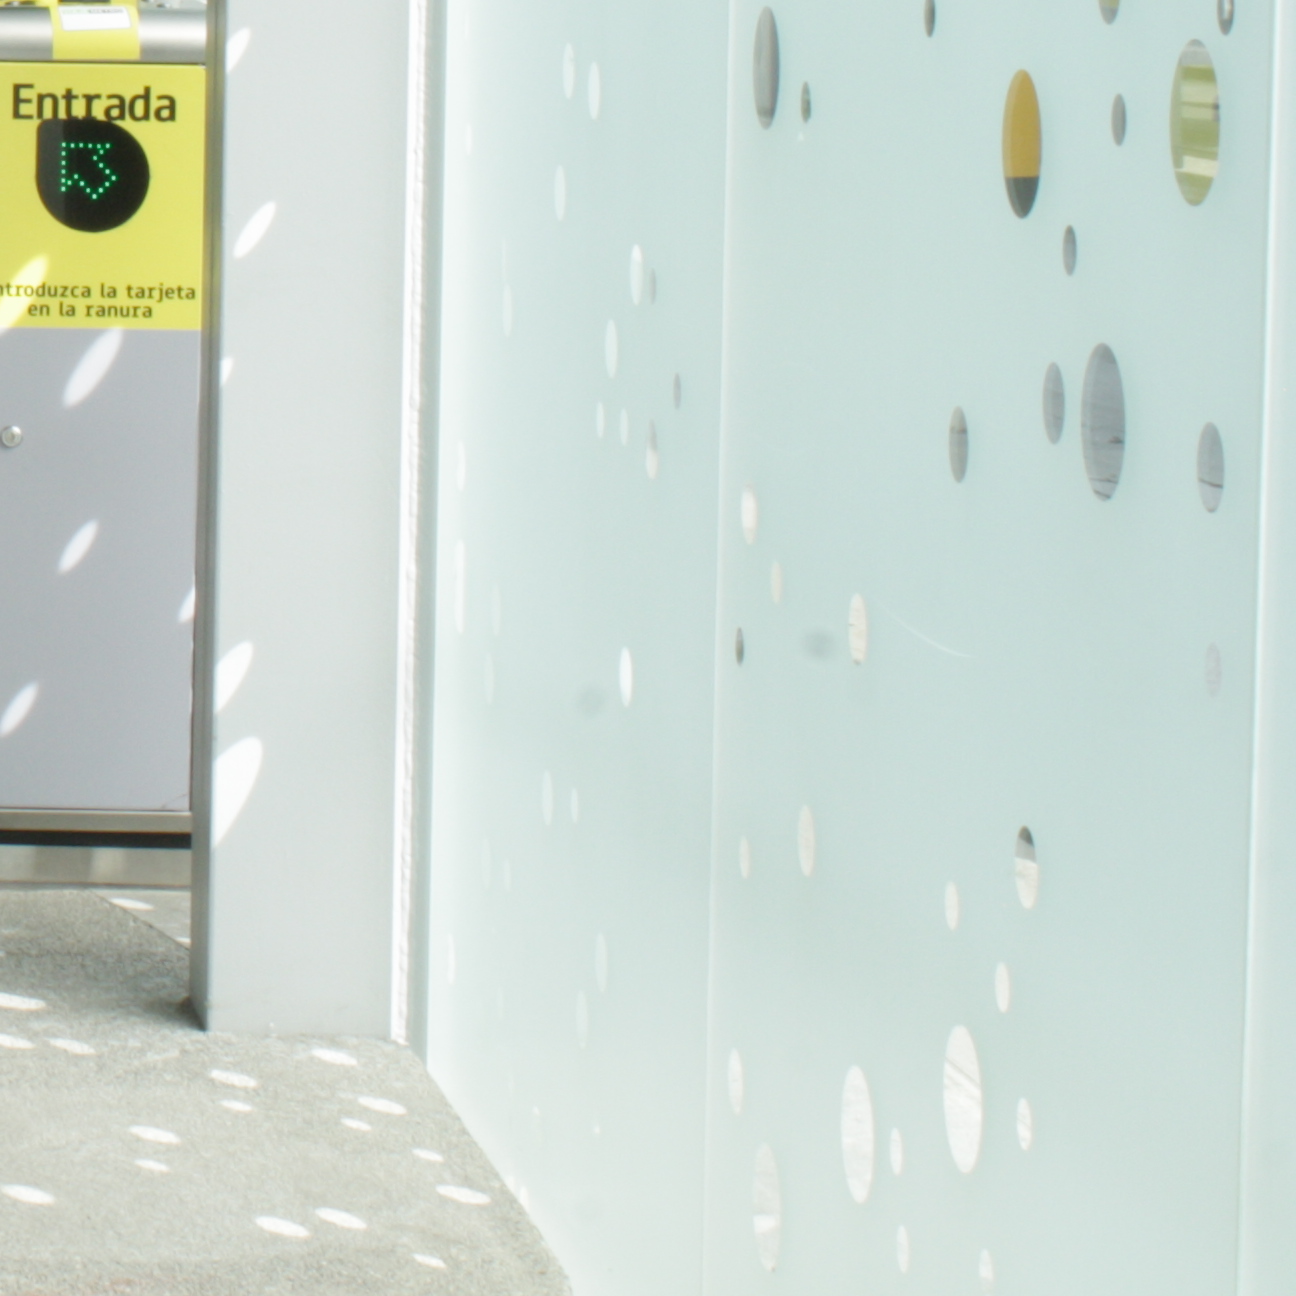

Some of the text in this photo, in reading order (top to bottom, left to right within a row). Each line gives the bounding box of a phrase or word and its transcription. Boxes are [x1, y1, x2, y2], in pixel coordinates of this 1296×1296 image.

[12, 83, 177, 122] Entrada
[100, 283, 117, 299] la
[126, 282, 196, 303] tarjeta
[27, 301, 153, 318] en la ranura
